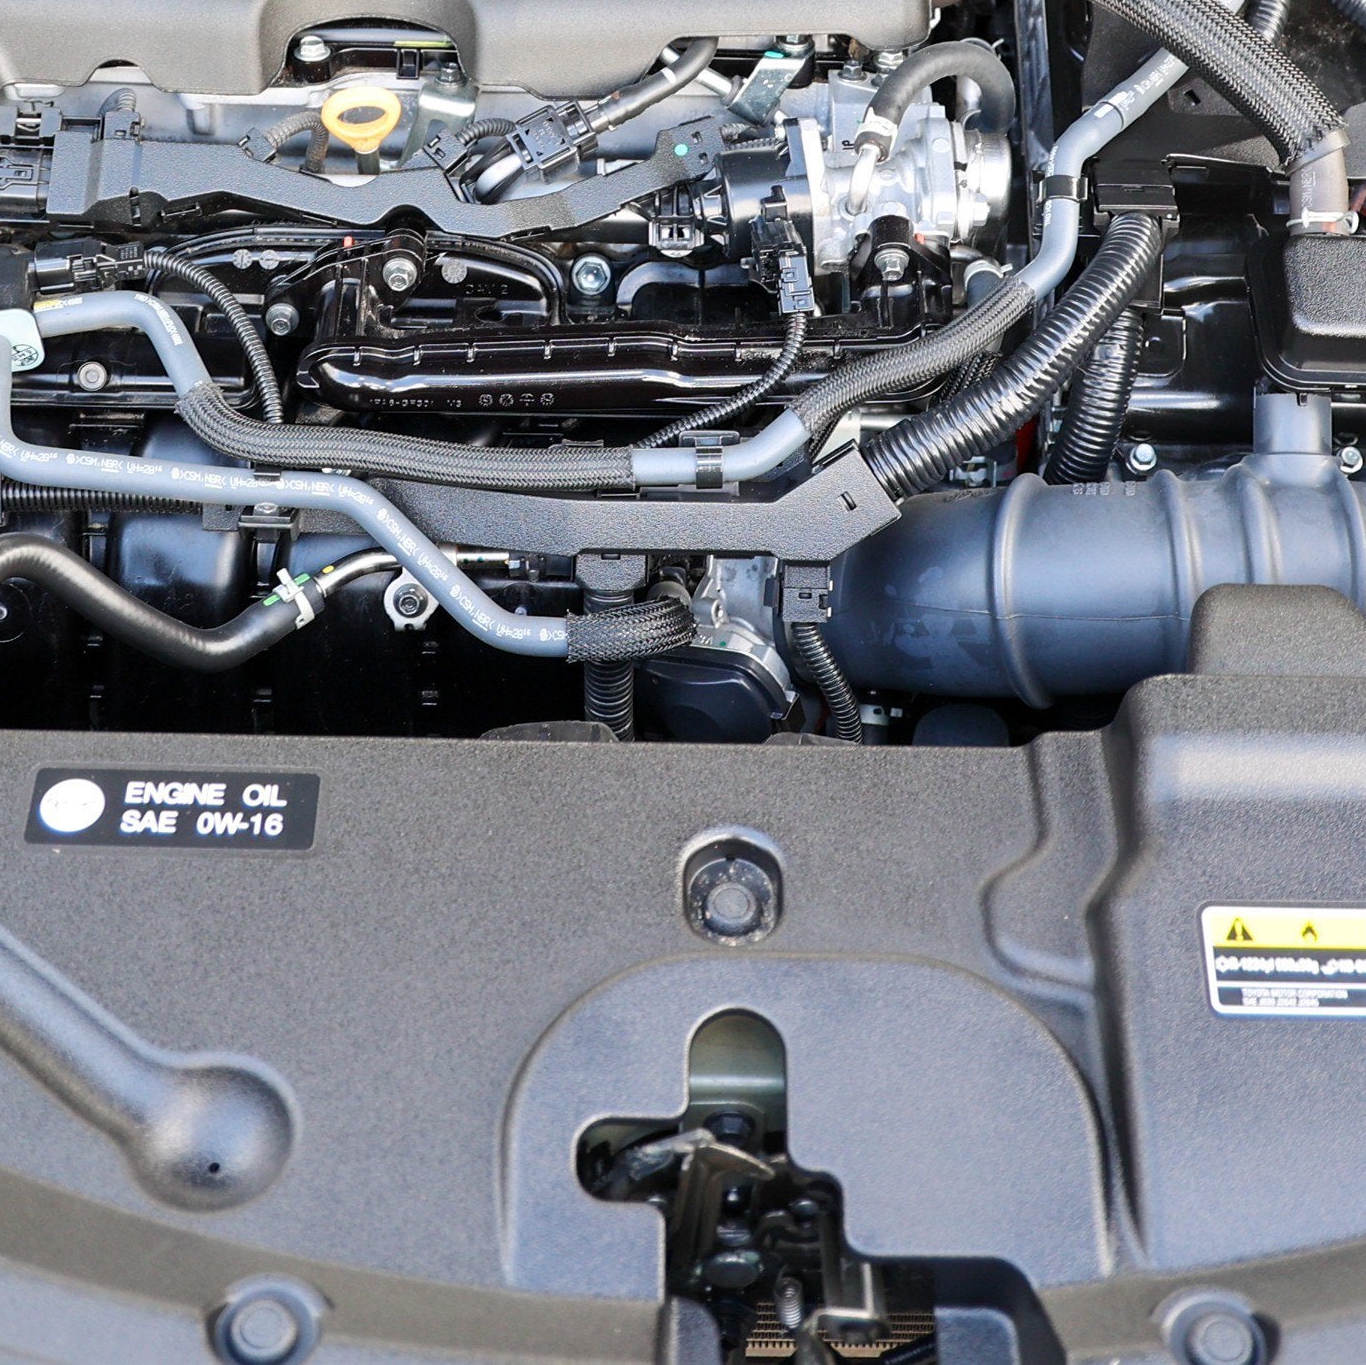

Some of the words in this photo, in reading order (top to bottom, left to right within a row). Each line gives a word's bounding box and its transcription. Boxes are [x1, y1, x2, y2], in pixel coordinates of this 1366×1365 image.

[124, 781, 227, 807] ENGINE
[242, 784, 287, 807] OIL
[120, 809, 179, 834] SAE
[196, 812, 284, 836] 0W-16
